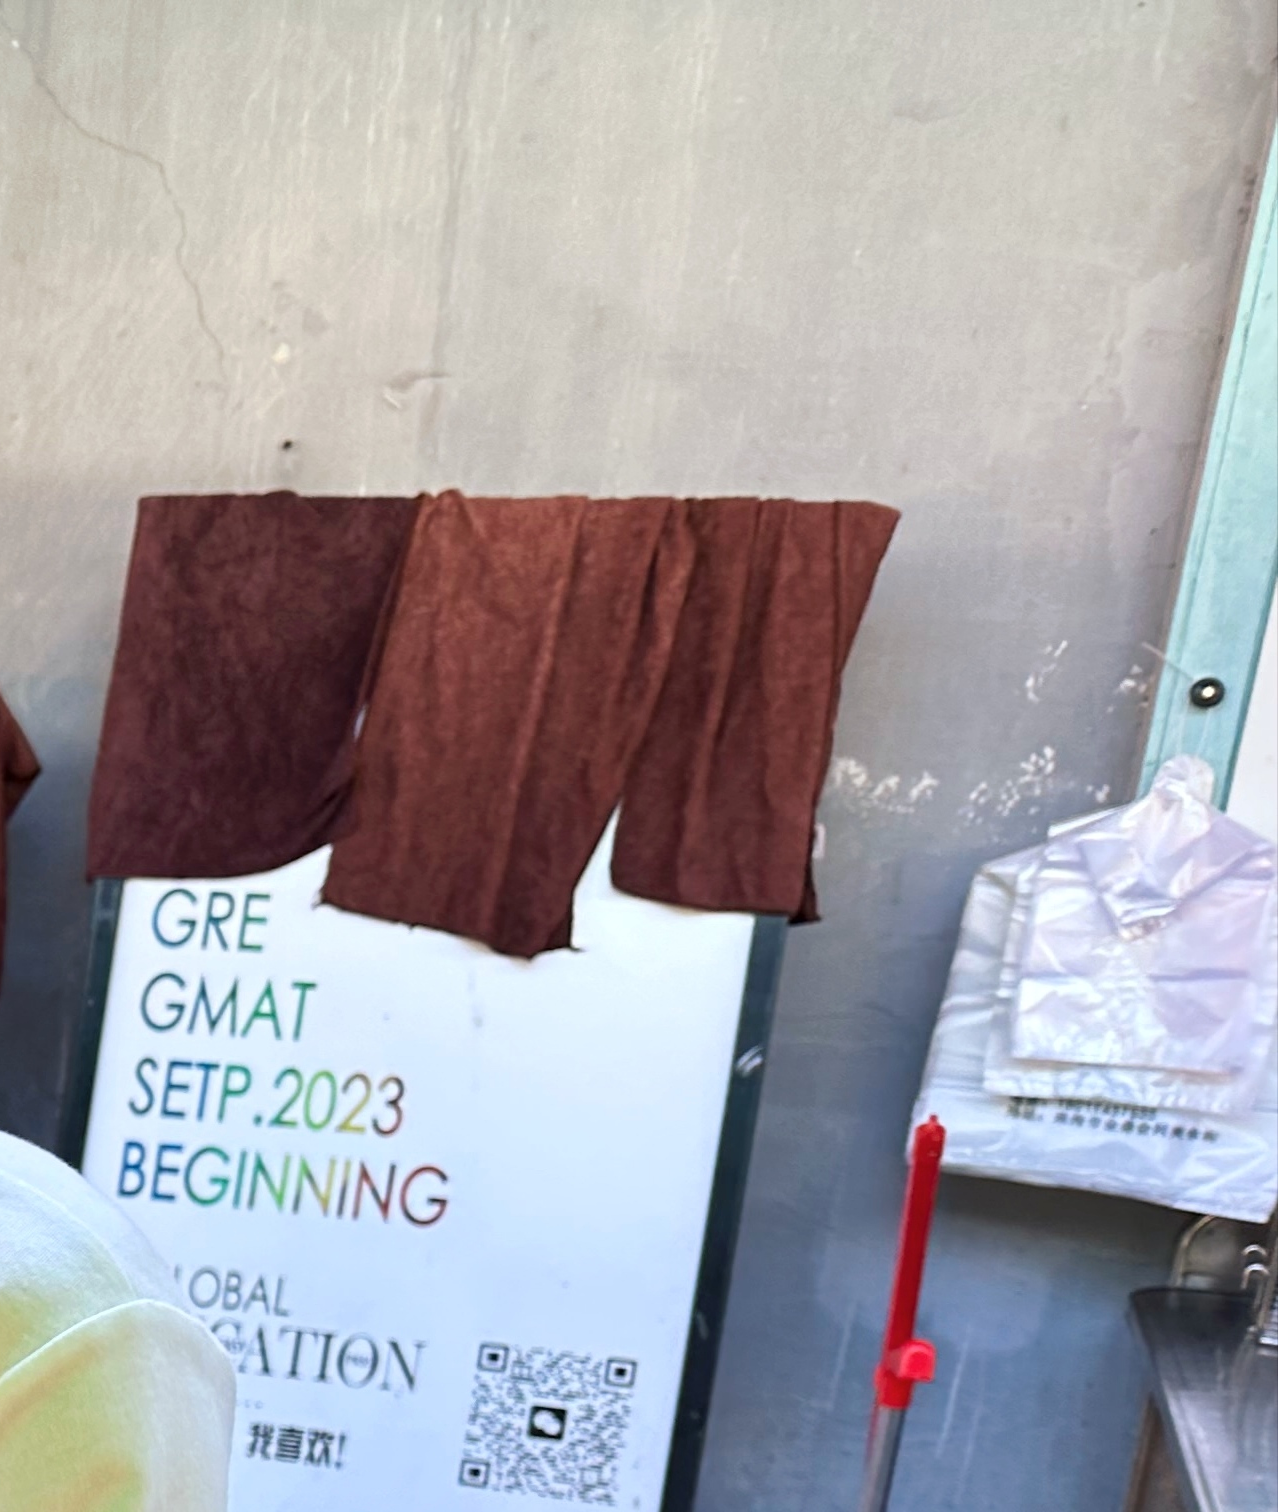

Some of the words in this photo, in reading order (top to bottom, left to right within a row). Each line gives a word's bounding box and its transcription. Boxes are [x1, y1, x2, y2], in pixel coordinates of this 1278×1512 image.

[152, 889, 271, 952] GRE
[141, 973, 318, 1042] GMAT
[129, 1057, 405, 1137] SETP.2023
[117, 1141, 449, 1226] BEGINNING
[174, 1264, 290, 1317] OBAL
